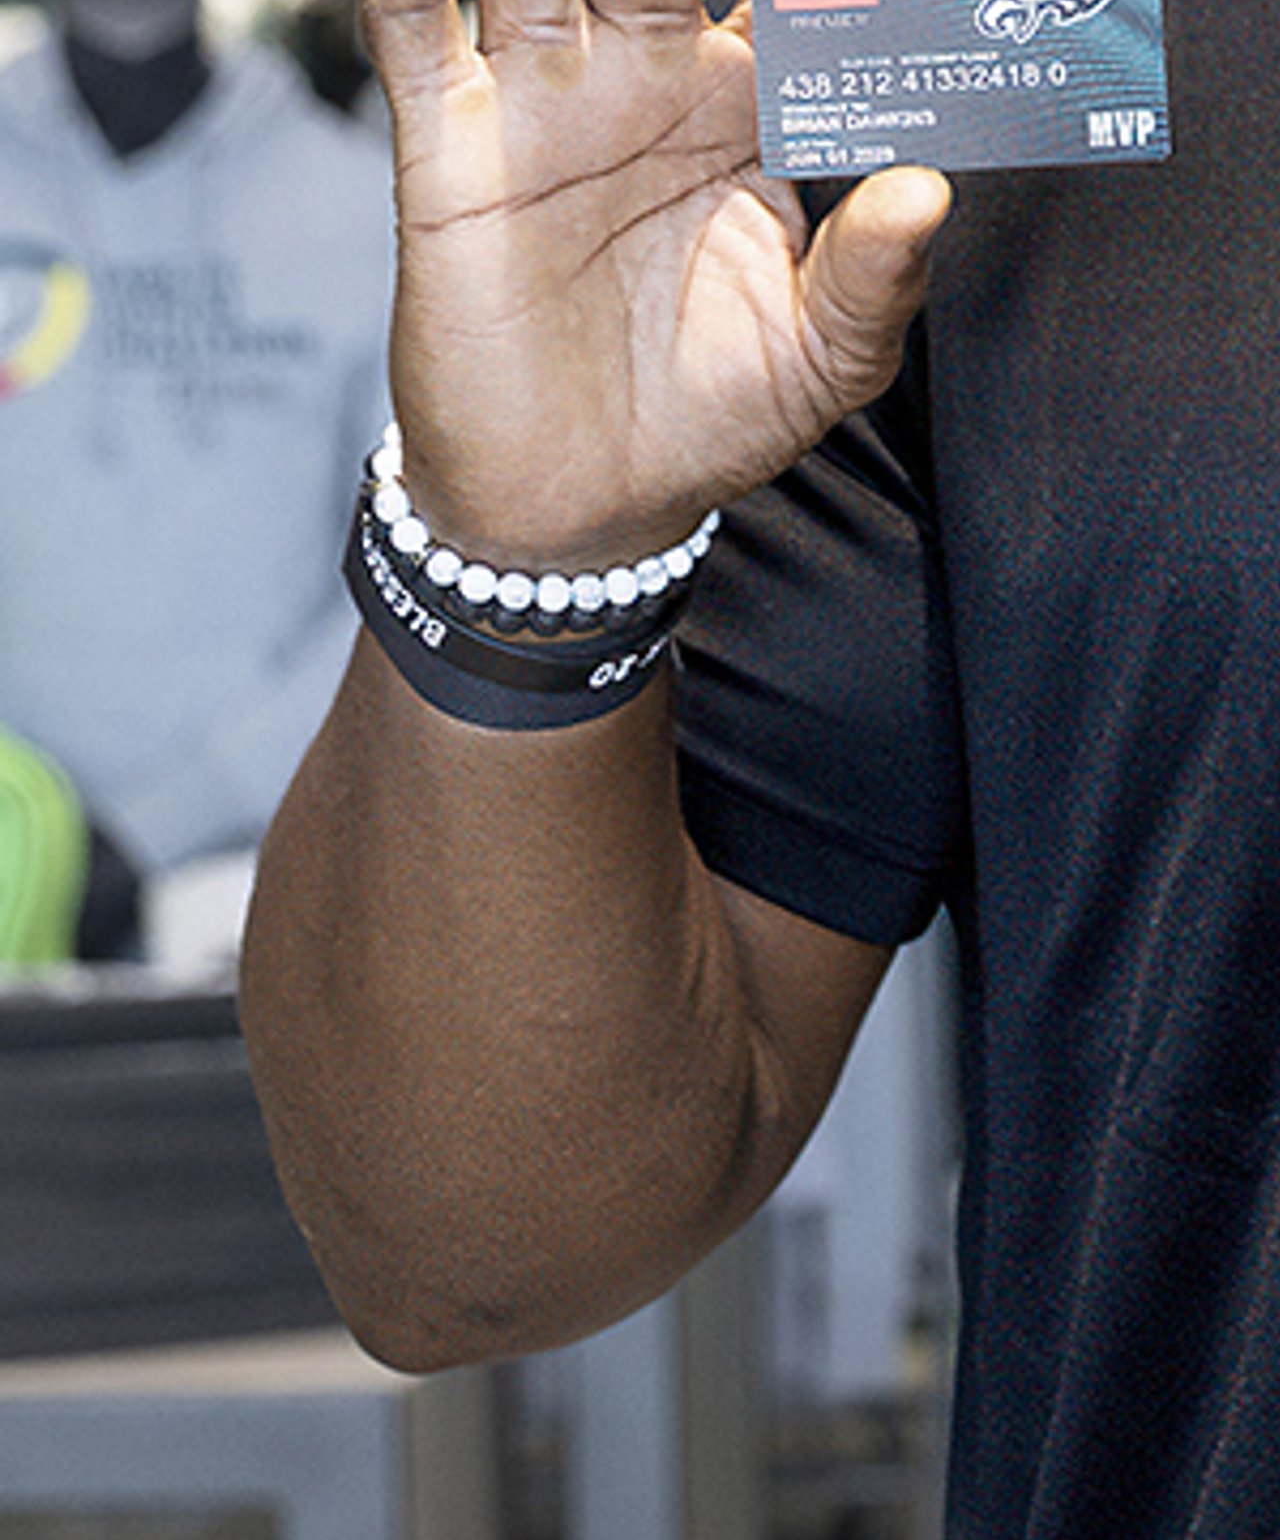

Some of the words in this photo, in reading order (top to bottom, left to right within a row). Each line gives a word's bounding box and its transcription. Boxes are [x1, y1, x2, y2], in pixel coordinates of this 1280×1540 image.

[779, 73, 833, 99] 438
[841, 71, 894, 96] 212
[901, 62, 1040, 92] 41332418
[1088, 111, 1156, 147] MVP
